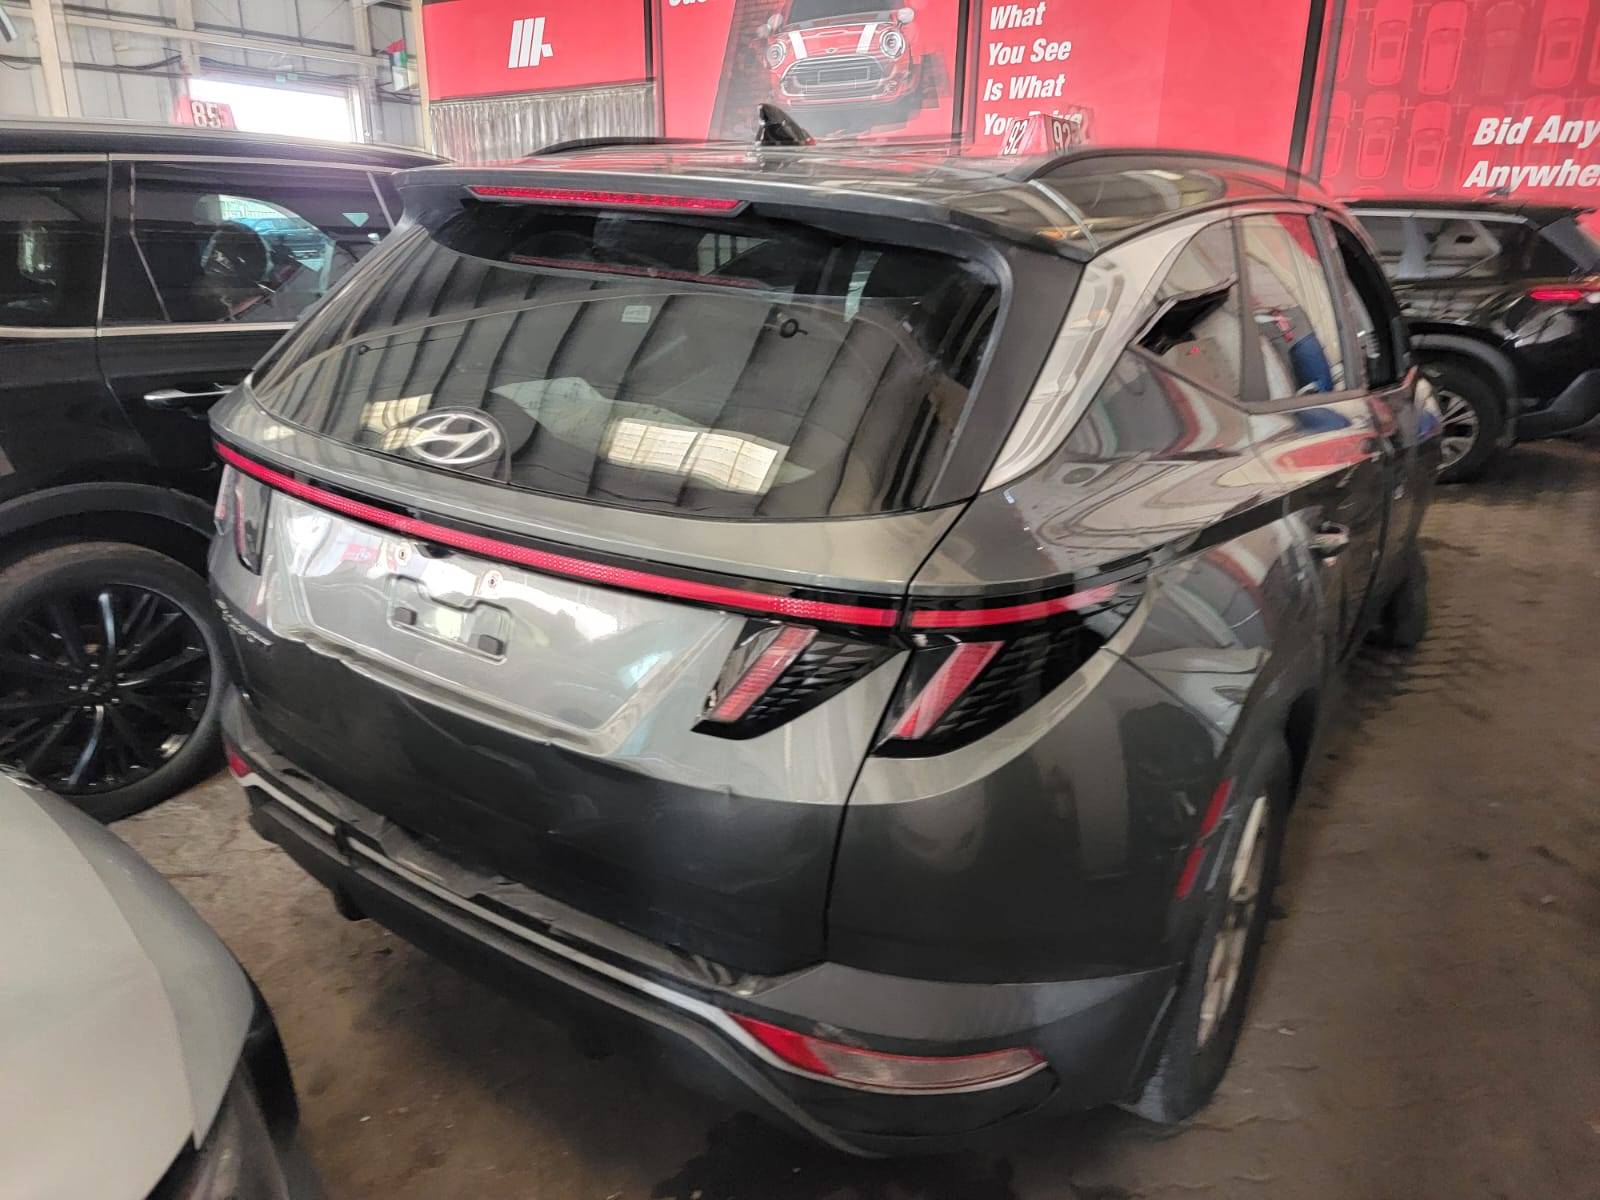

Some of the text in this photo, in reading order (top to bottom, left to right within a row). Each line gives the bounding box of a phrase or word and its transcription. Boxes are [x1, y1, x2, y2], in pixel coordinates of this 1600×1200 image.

[990, 2, 1046, 30] What
[989, 38, 1072, 66] You See
[983, 74, 1066, 101] Is What
[1003, 119, 1028, 155] 92
[1472, 116, 1533, 145] Bid
[1462, 159, 1600, 192] Anywhe
